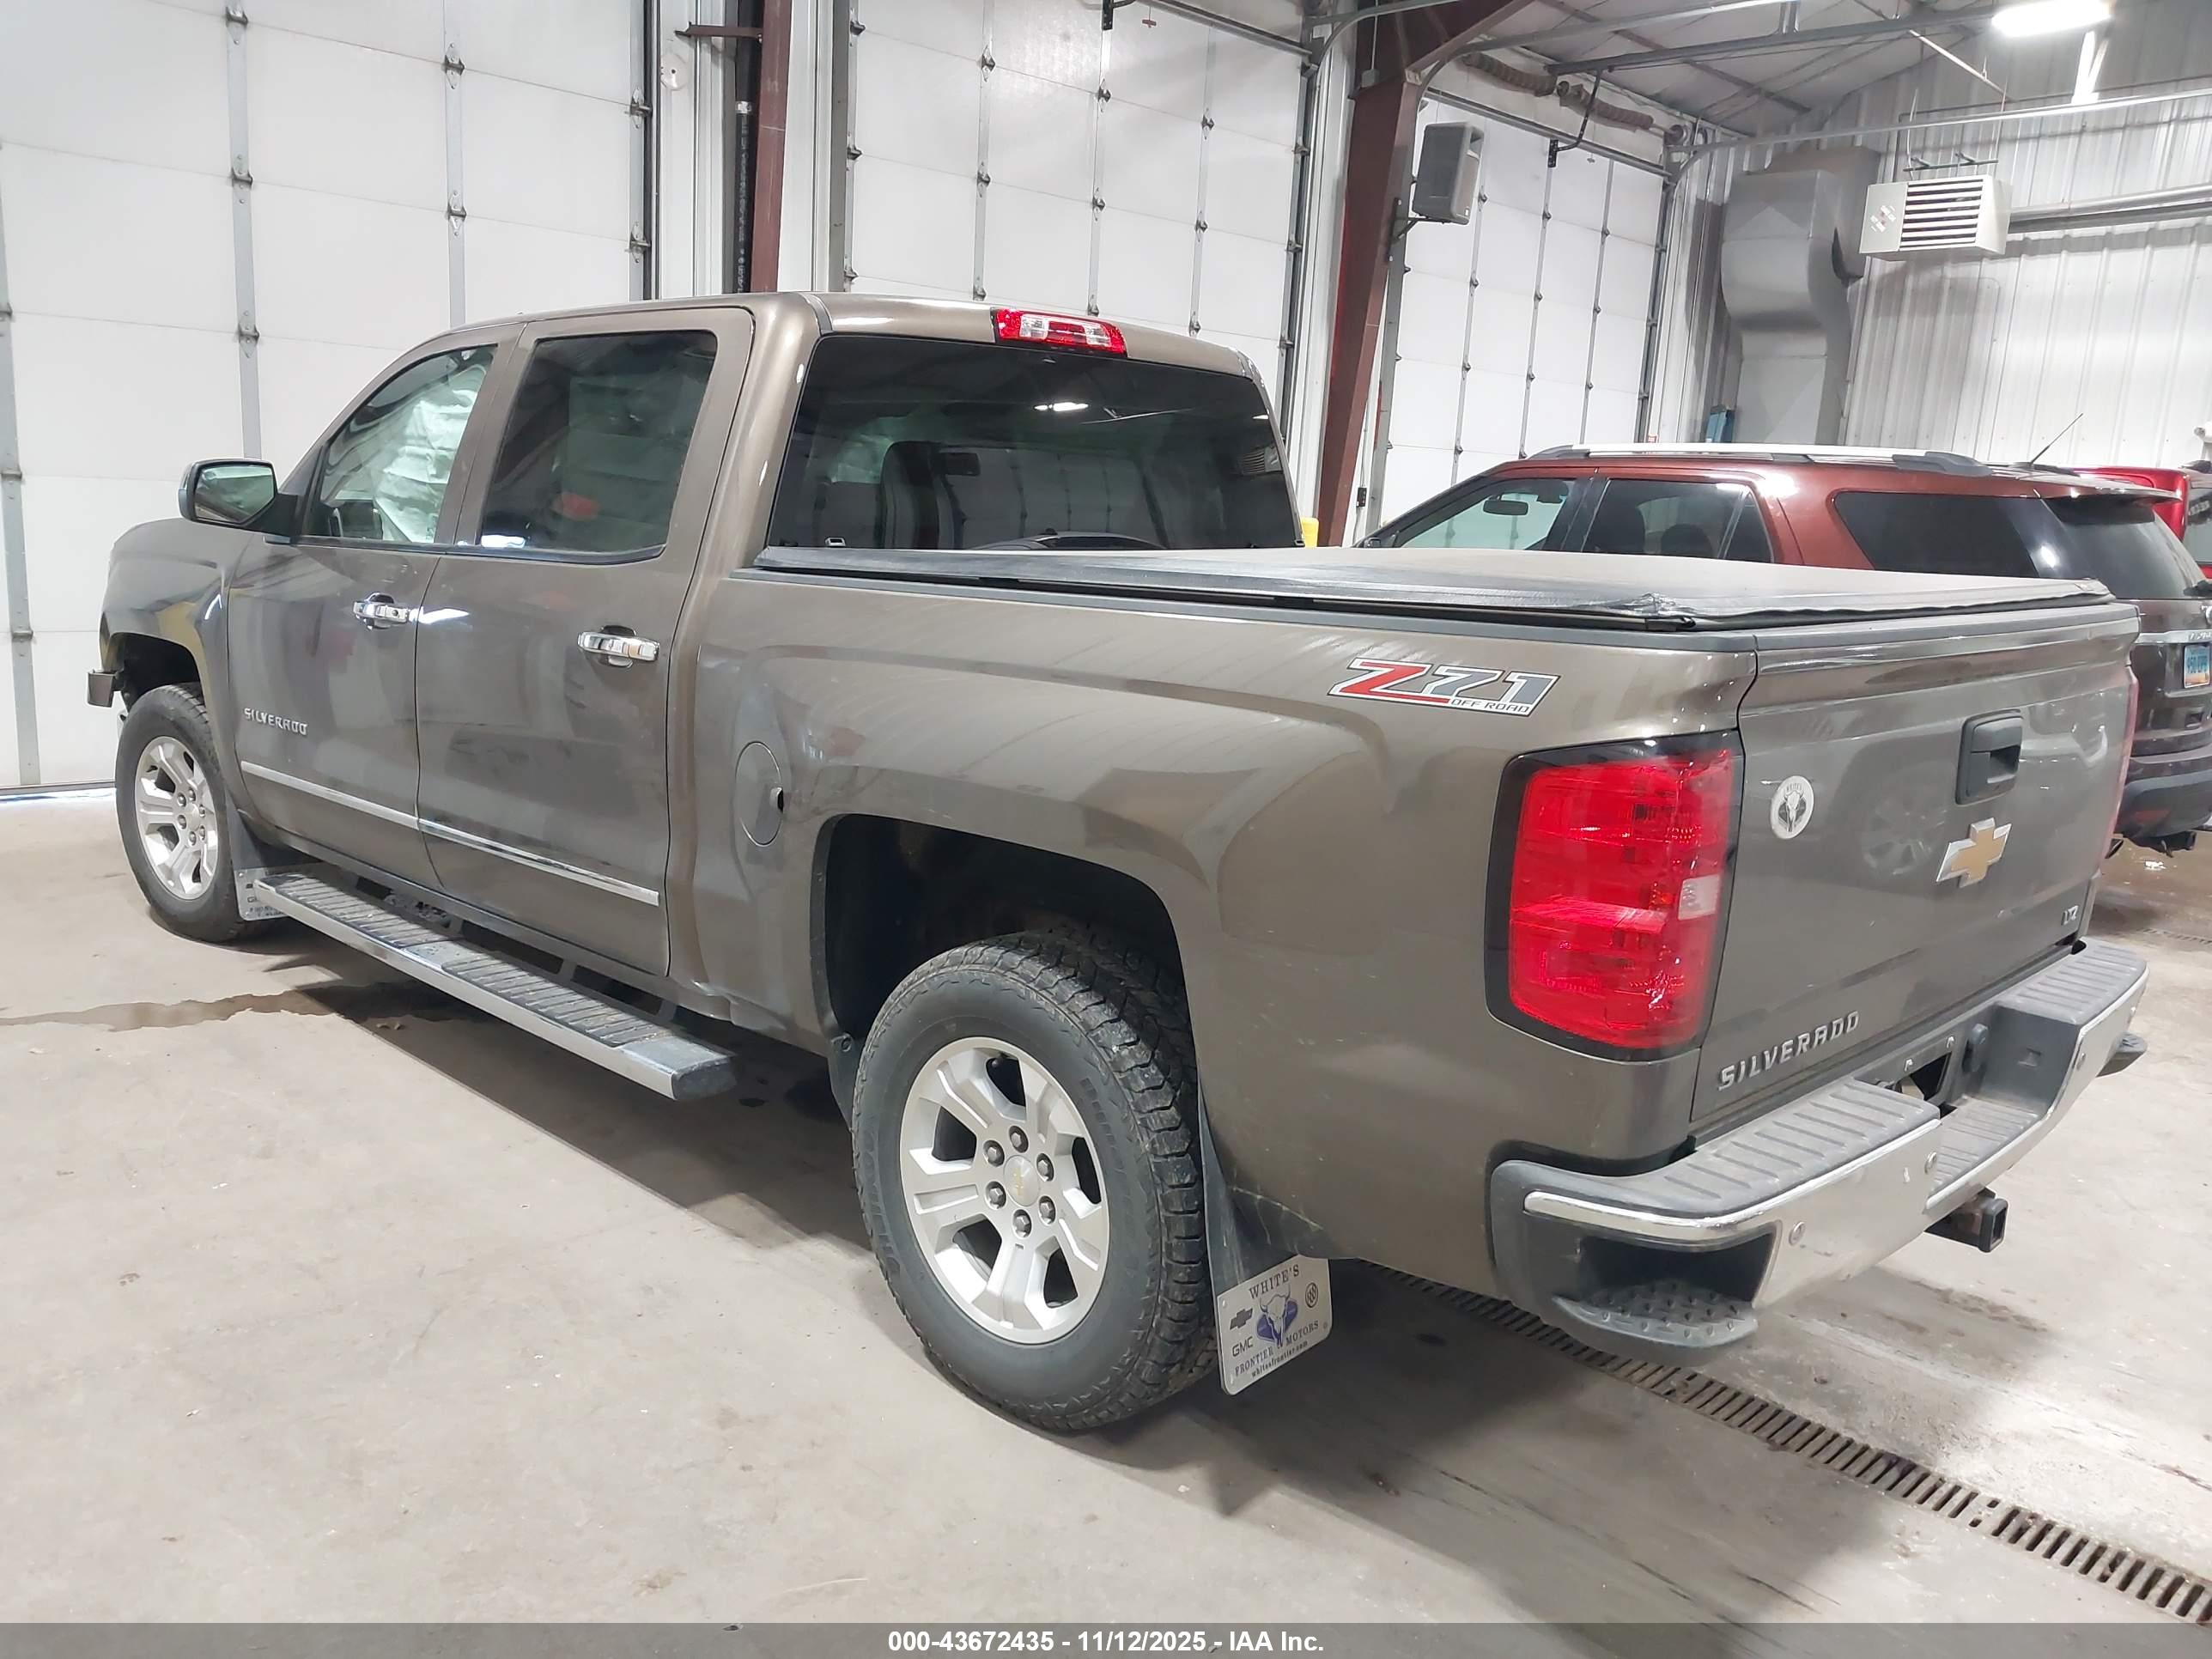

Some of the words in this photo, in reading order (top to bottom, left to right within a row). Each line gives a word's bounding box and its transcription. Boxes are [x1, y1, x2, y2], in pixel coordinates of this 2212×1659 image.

[1328, 657, 1561, 714] Z71
[243, 707, 308, 736] SILVERADO
[1450, 697, 1482, 708] OFF
[1484, 701, 1530, 714] ROAD
[1717, 1010, 1860, 1091] SILVERADO
[1249, 1264, 1300, 1299] WHITE'S
[1231, 1336, 1254, 1357] GMC
[1235, 1346, 1273, 1377] FRONTIER
[1285, 1320, 1319, 1347] MOTORS
